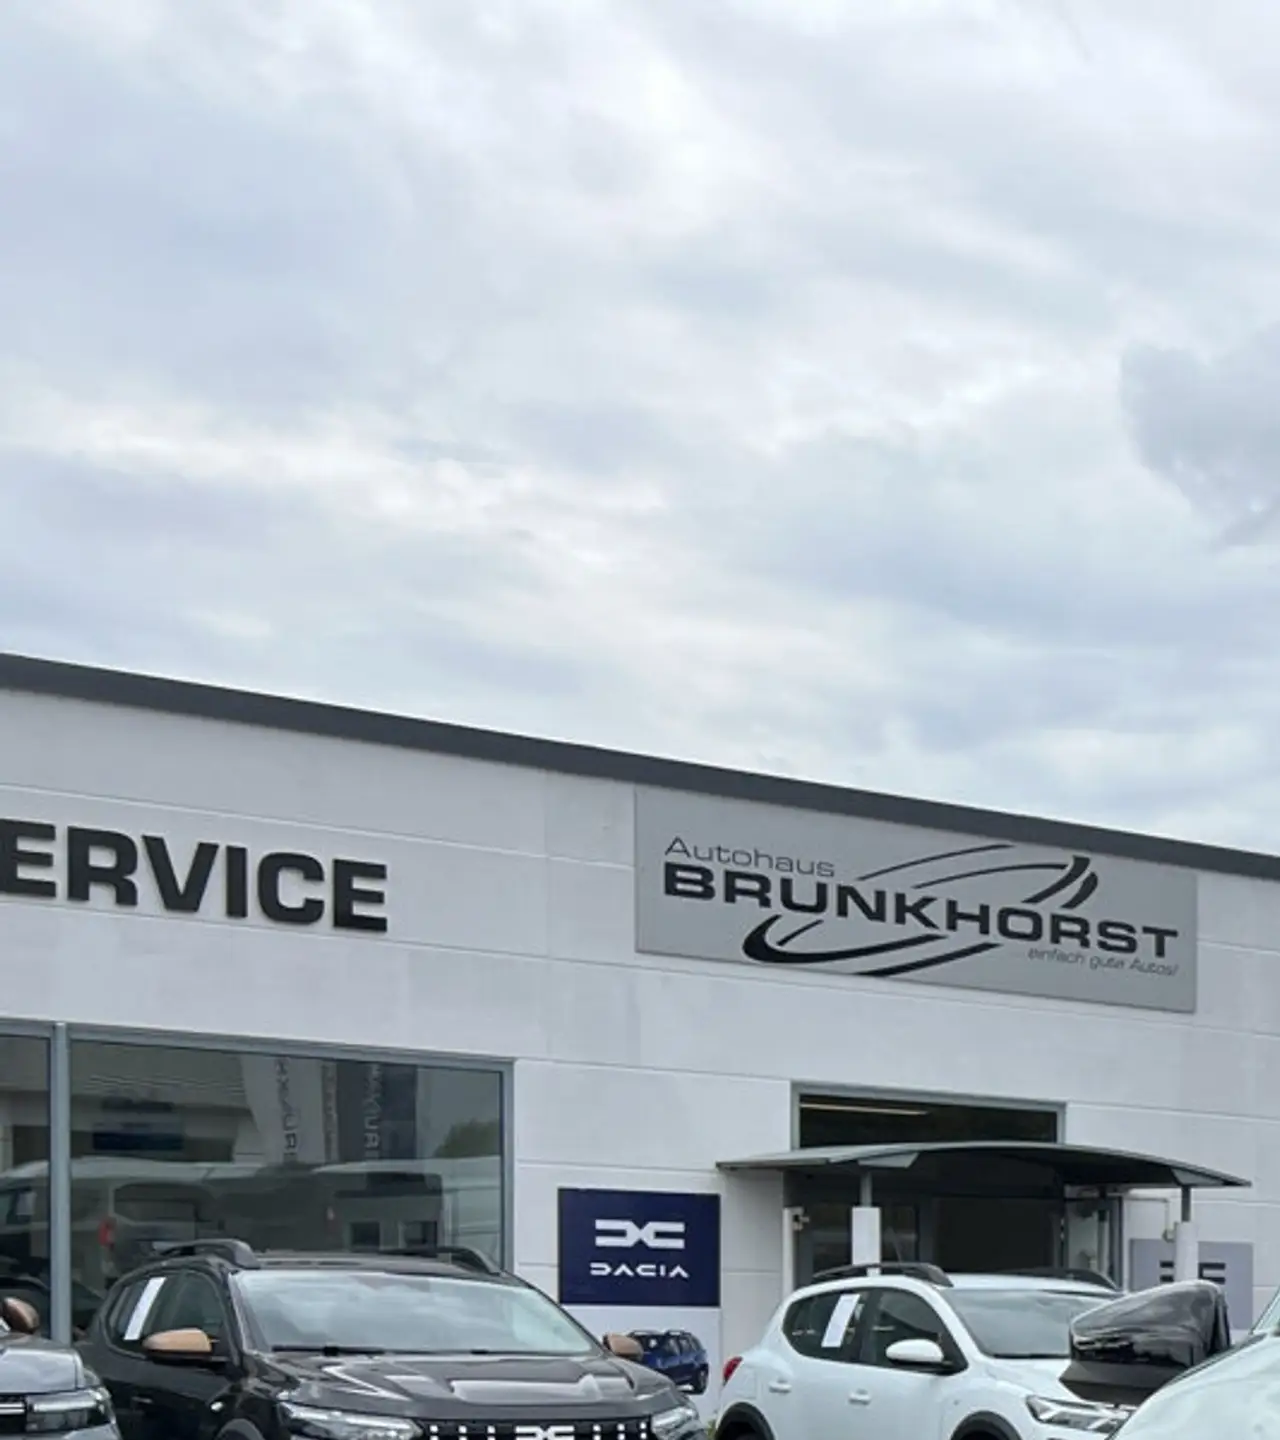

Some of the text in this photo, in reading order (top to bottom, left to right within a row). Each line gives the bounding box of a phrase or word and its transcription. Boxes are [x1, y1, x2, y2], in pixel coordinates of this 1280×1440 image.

[0, 818, 388, 933] ERVICE
[664, 837, 835, 878] Autohaus
[664, 862, 1179, 958] BRUNKHORST
[590, 1262, 690, 1278] DACIA
